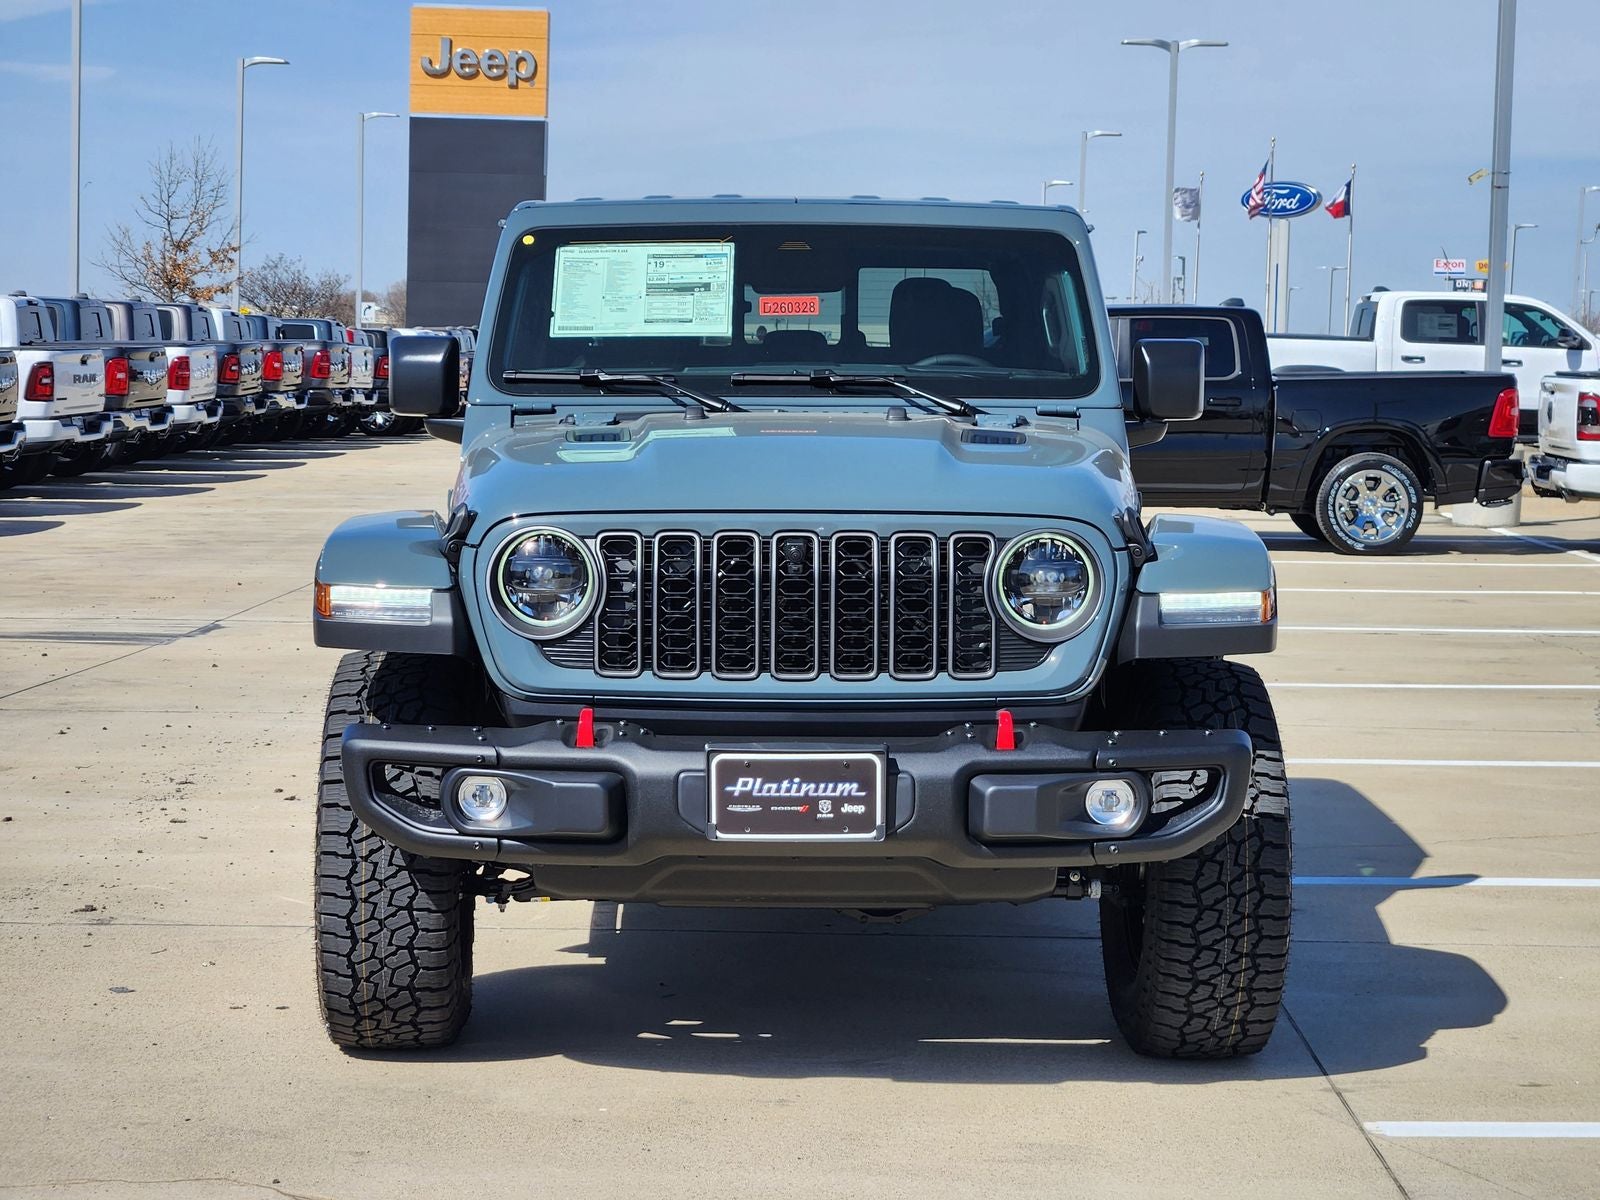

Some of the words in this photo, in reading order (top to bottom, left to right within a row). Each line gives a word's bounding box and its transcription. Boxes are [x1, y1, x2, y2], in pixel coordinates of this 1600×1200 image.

[420, 36, 537, 89] Jeep
[1262, 188, 1301, 210] Ford
[653, 260, 665, 268] 19
[1436, 259, 1465, 271] Exxon
[763, 301, 816, 314] D260328
[73, 373, 97, 384] RAM
[724, 777, 867, 797] Platinum
[841, 803, 866, 814] Jeep
